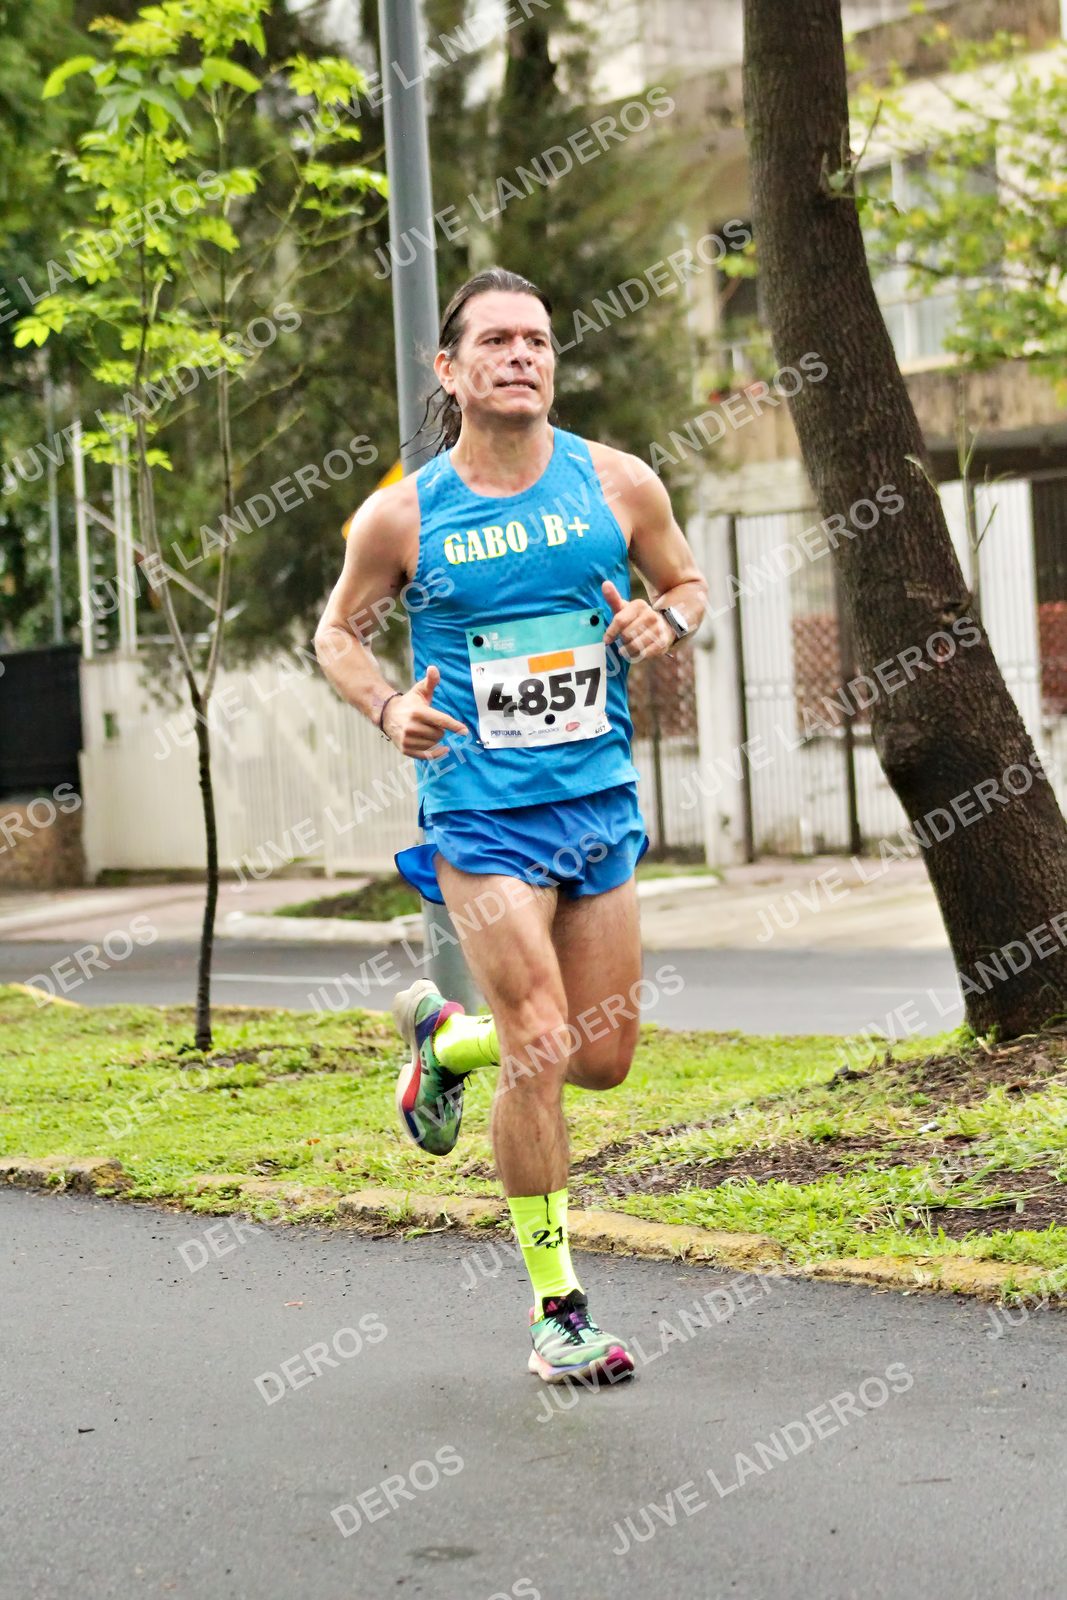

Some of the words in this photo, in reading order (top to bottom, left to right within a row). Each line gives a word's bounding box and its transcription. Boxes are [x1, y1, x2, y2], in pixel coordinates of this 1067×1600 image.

[444, 521, 528, 565] GABO
[541, 514, 590, 547] B+
[487, 667, 601, 715] 4857
[532, 1226, 564, 1246] 21
